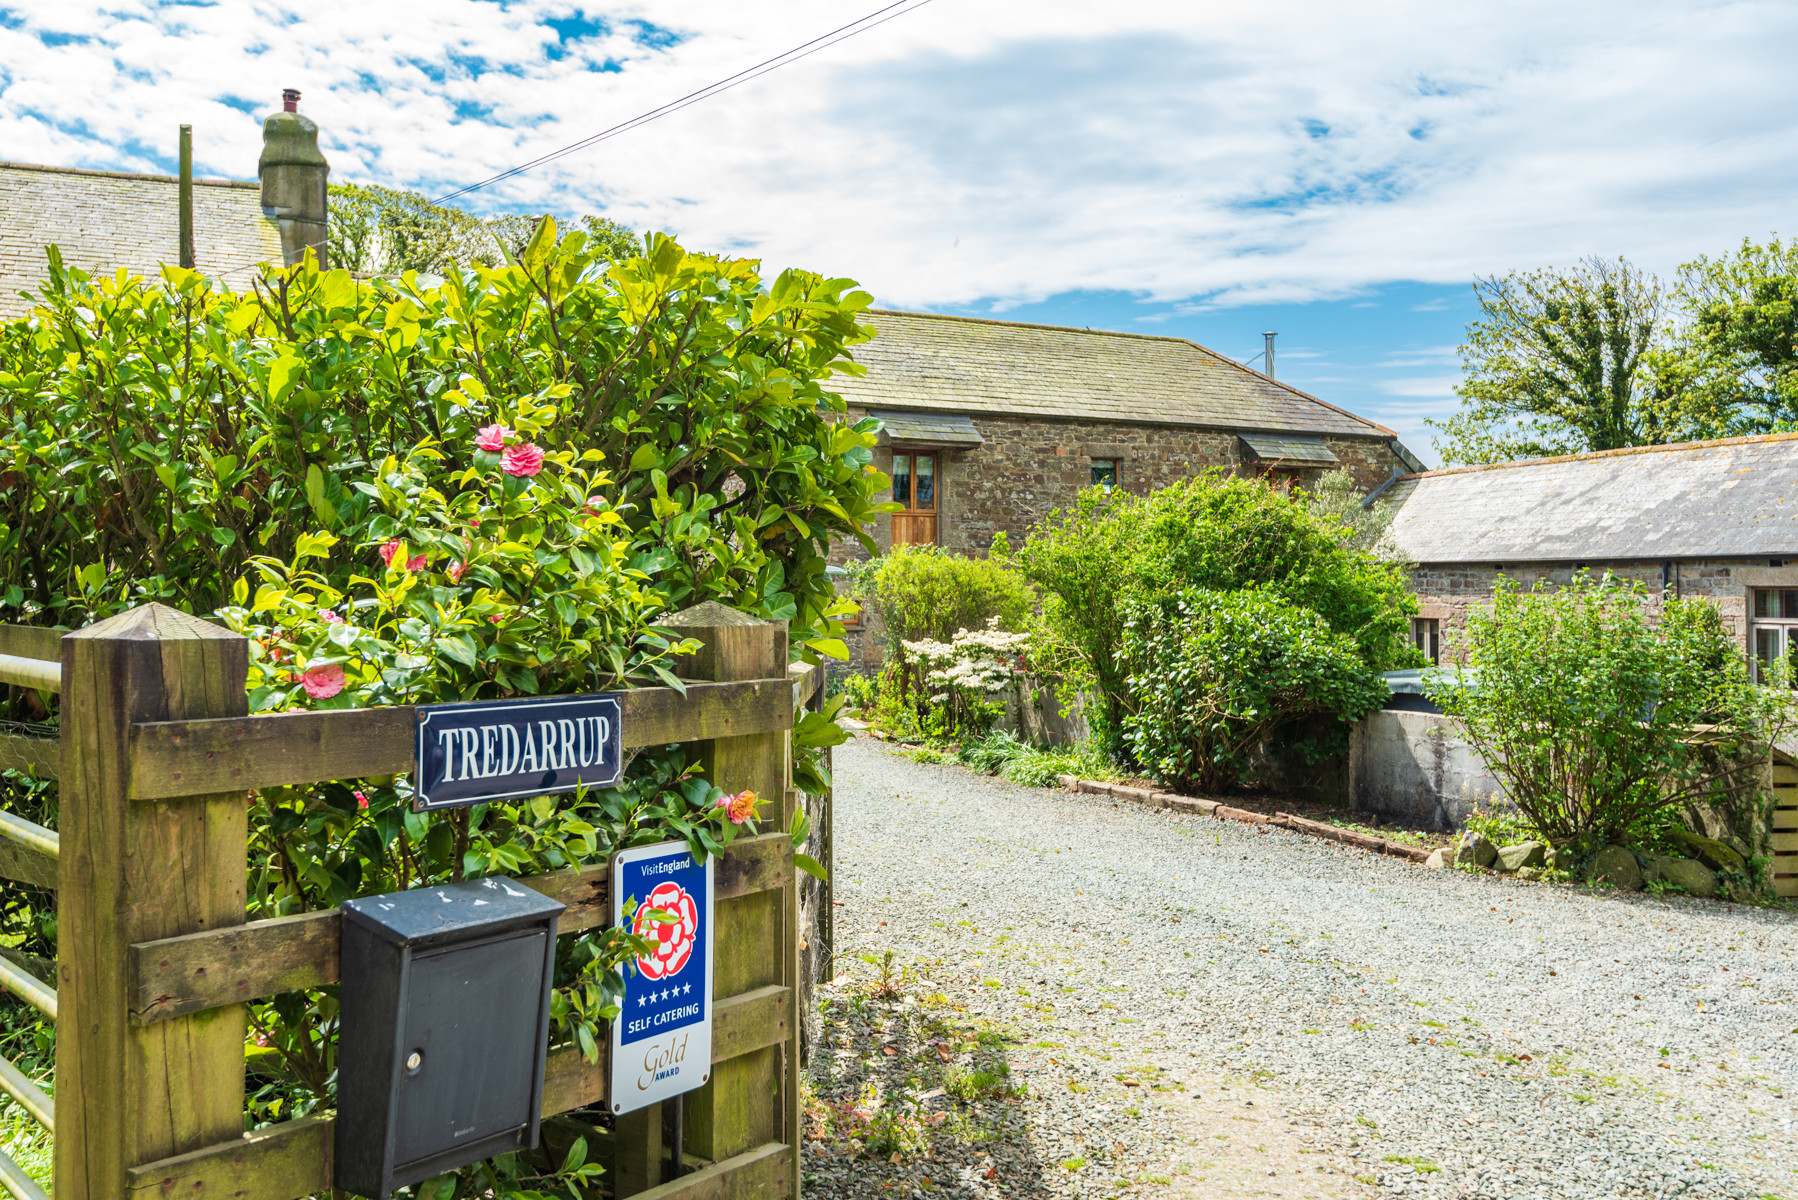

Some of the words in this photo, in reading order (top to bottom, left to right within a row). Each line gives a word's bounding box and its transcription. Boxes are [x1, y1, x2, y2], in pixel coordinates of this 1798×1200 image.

[438, 716, 610, 782] TREDARRUP
[628, 1017, 651, 1034] SELF
[654, 1003, 699, 1026] CATERING
[637, 1033, 689, 1091] Gold
[655, 1067, 680, 1082] AWARD
